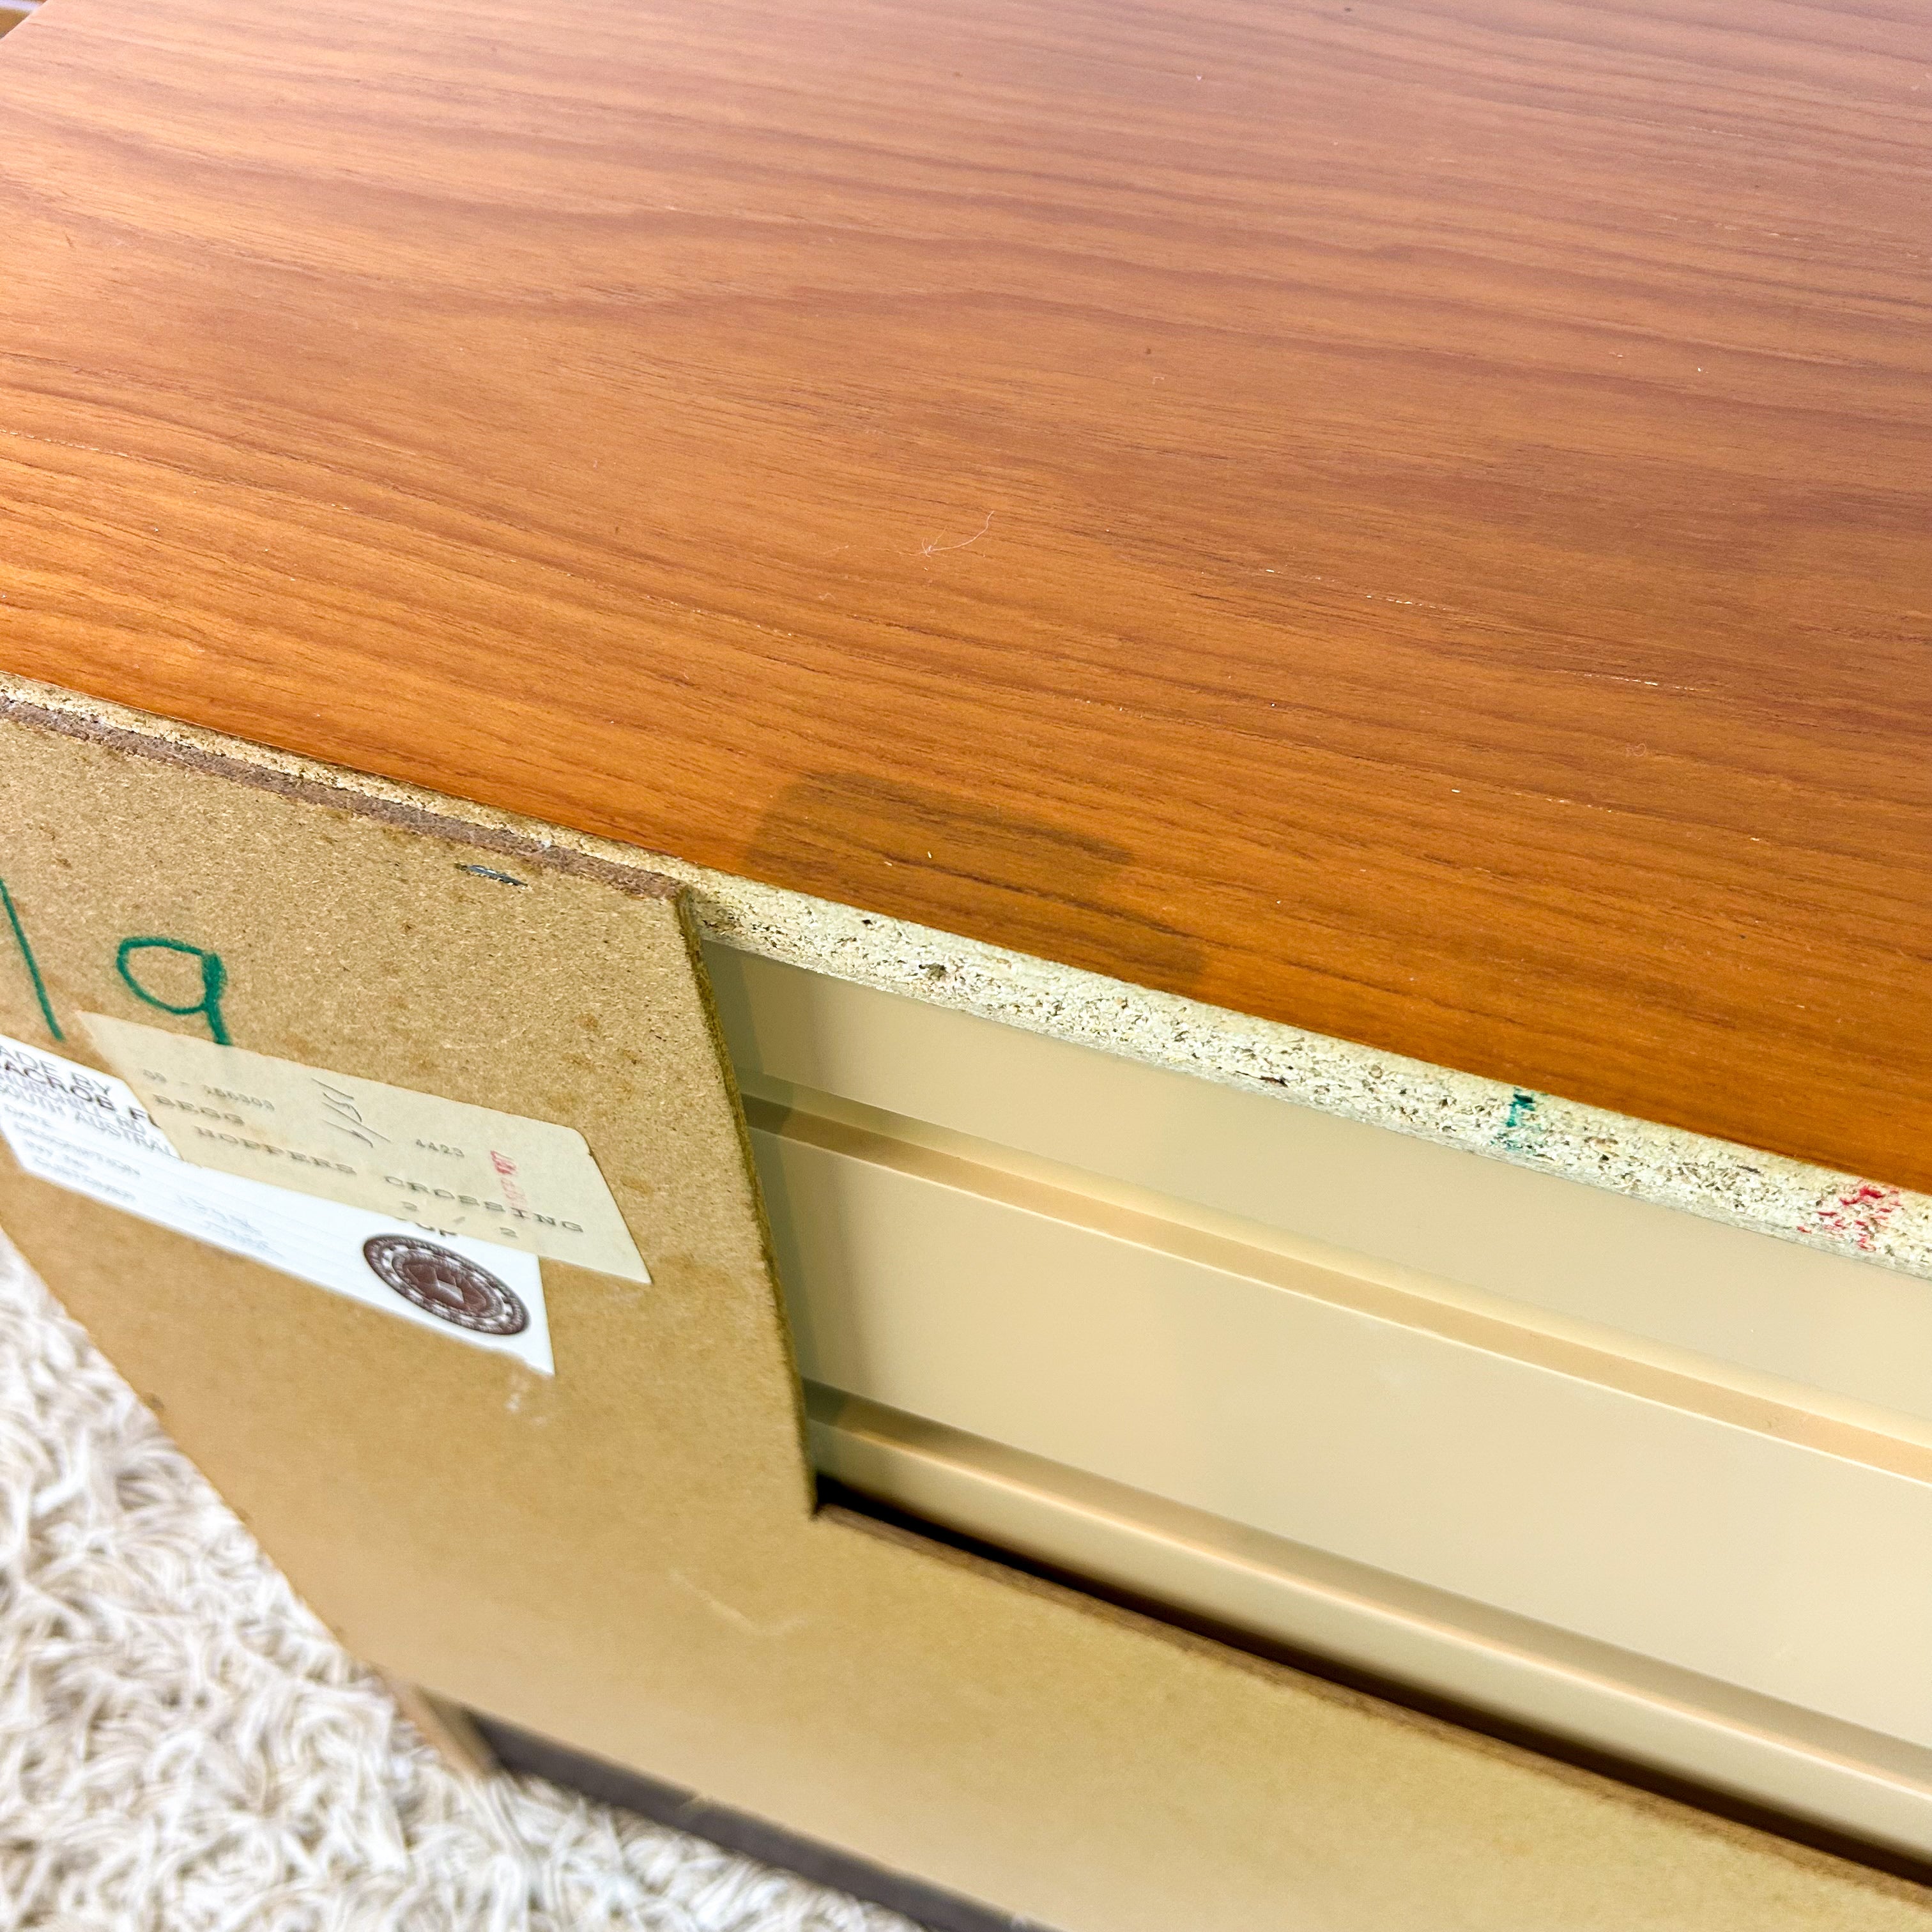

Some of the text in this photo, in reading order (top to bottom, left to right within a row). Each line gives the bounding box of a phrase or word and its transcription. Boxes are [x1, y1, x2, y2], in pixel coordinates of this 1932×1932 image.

[0, 1059, 117, 1112] ACROB
[70, 1071, 111, 1096] BY
[193, 1124, 357, 1176] HOPPERS
[383, 1175, 583, 1233] CROSSING
